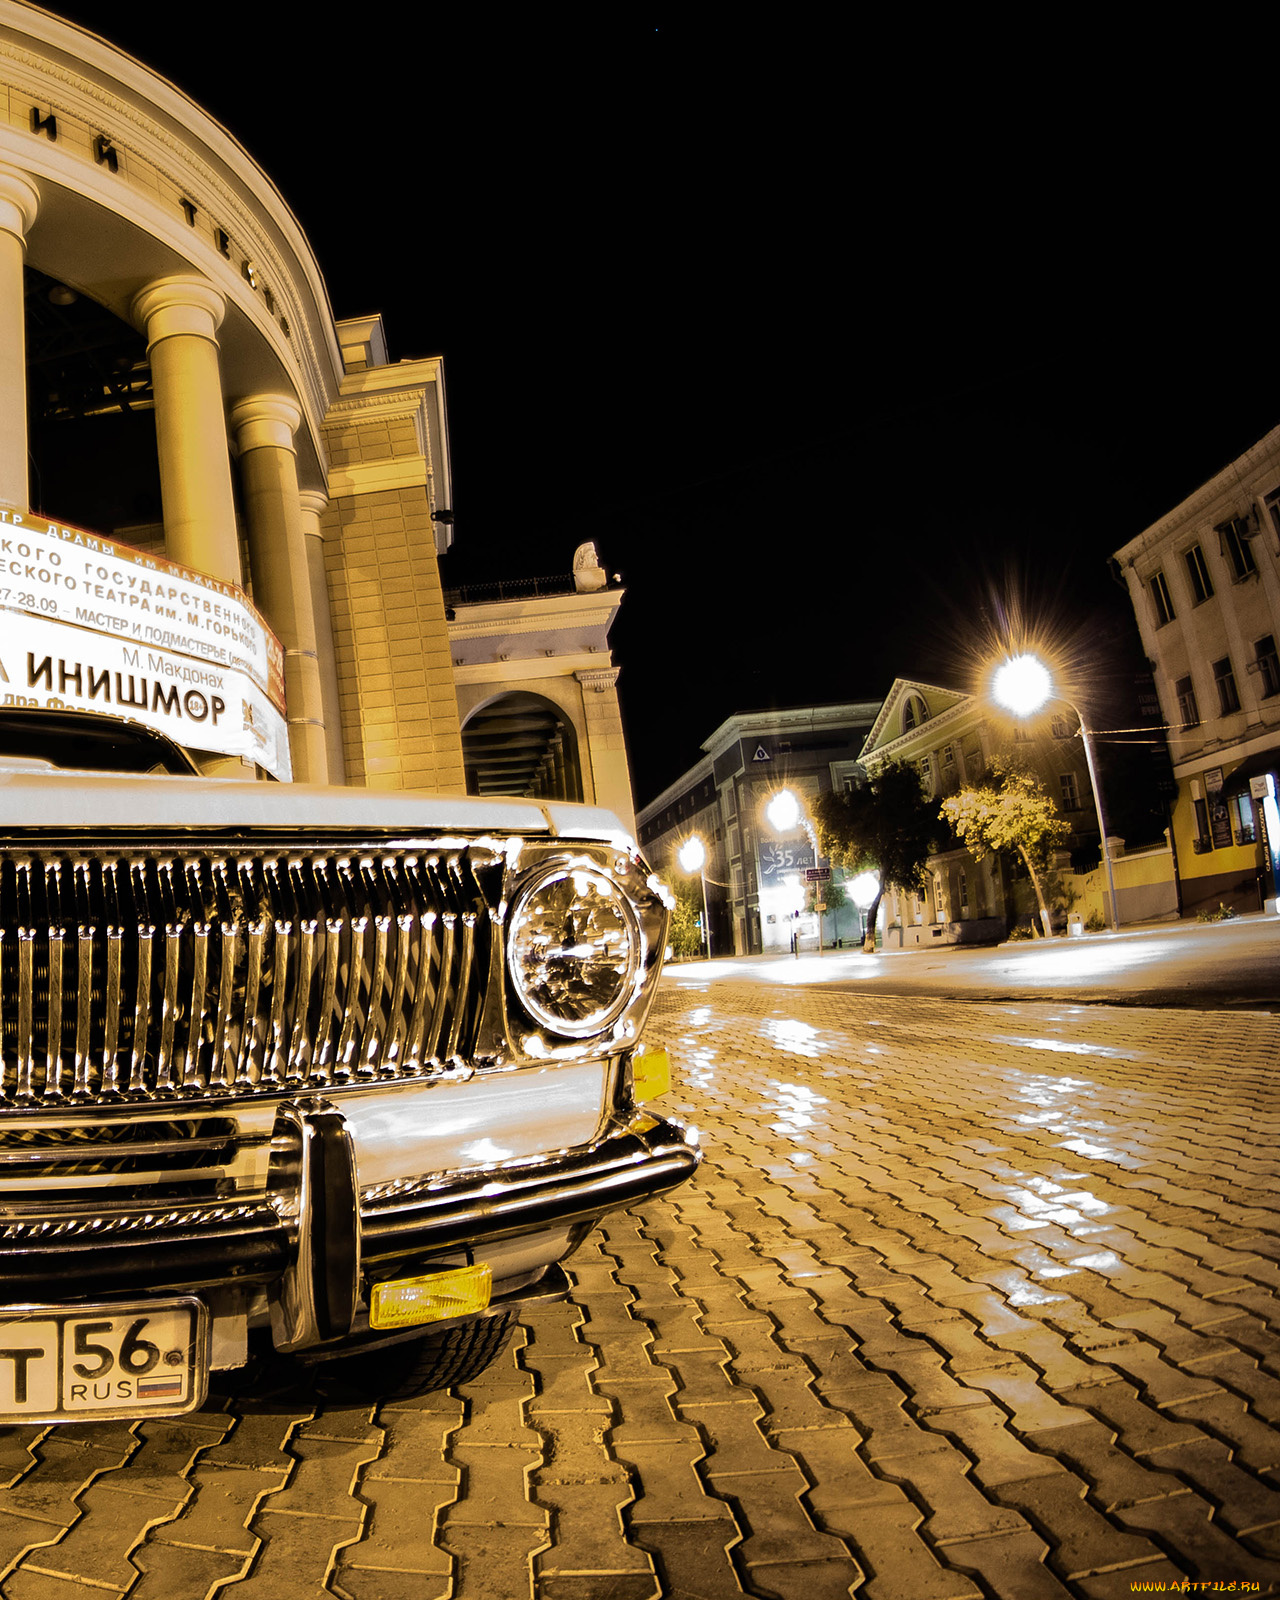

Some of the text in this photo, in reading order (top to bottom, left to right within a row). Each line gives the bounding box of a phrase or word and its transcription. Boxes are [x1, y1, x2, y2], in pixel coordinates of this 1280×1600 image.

[47, 524, 115, 556] ДРАМЫ
[169, 564, 230, 597] МАЖИТА
[82, 580, 151, 612] ТЕАТРА
[75, 606, 129, 631] МАСТЕР
[132, 622, 141, 635] И
[145, 625, 227, 662] ПОДМАСТЕРЬЕ
[26, 650, 226, 727] ИНИШМОР
[122, 646, 144, 669] М.
[148, 653, 224, 690] Макдонах
[775, 849, 814, 868] 35 лет
[73, 1318, 161, 1379] 56
[70, 1378, 133, 1401] RUS
